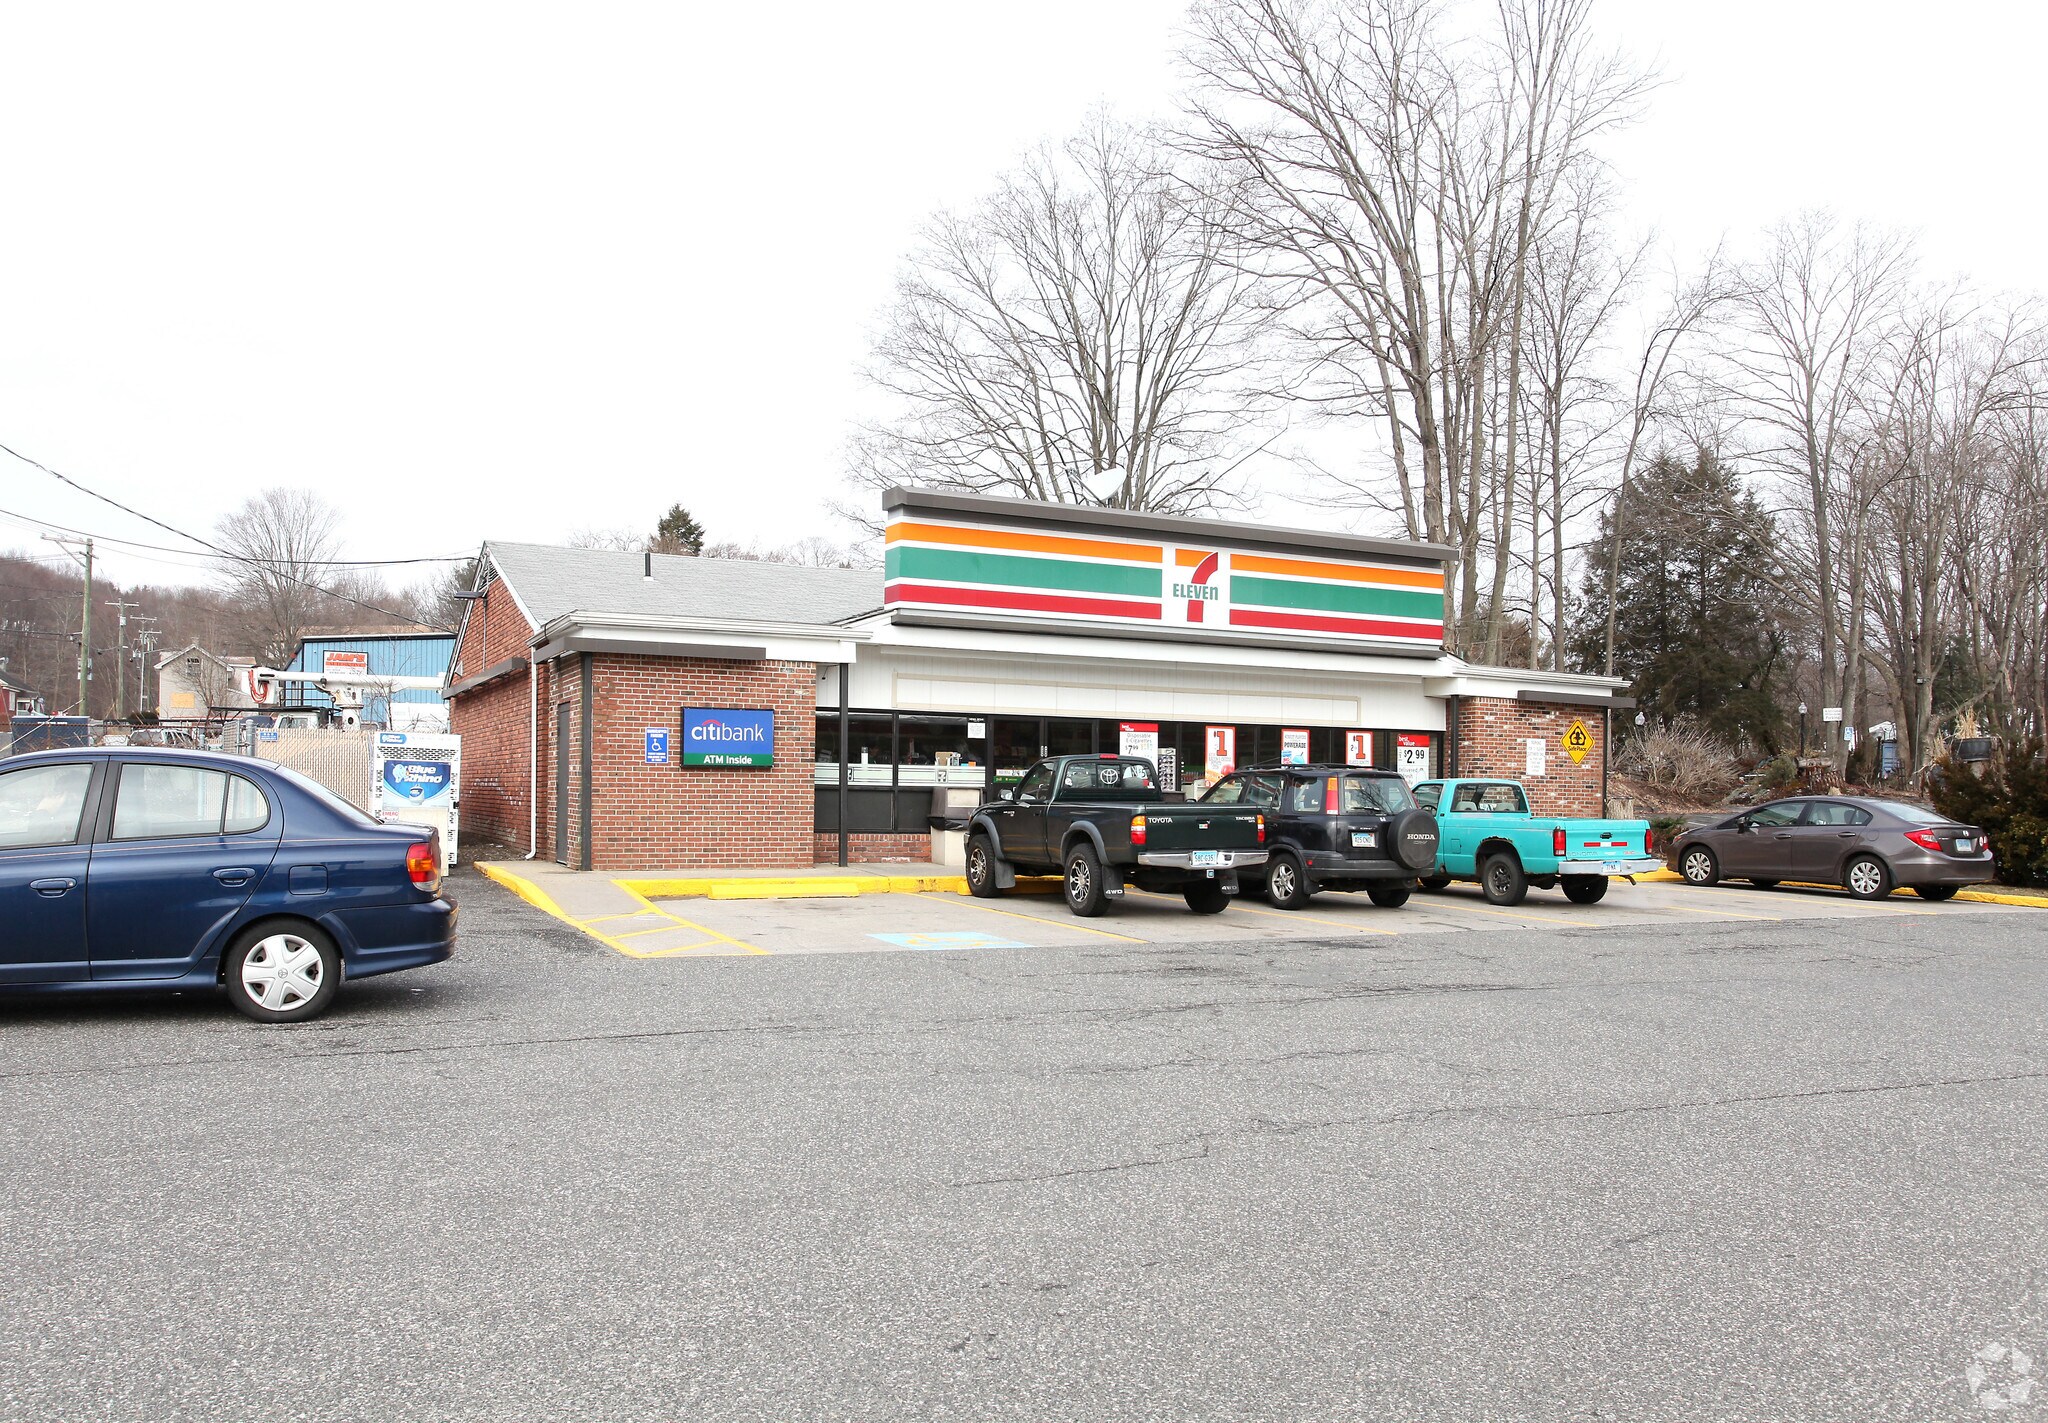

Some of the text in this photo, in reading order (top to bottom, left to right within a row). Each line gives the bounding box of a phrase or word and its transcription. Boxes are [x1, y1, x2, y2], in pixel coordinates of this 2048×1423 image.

[1176, 549, 1219, 623] 7
[691, 723, 764, 741] citibank
[703, 755, 752, 765] ATM Inside
[407, 764, 437, 774] Blue
[405, 774, 443, 783] Rhino
